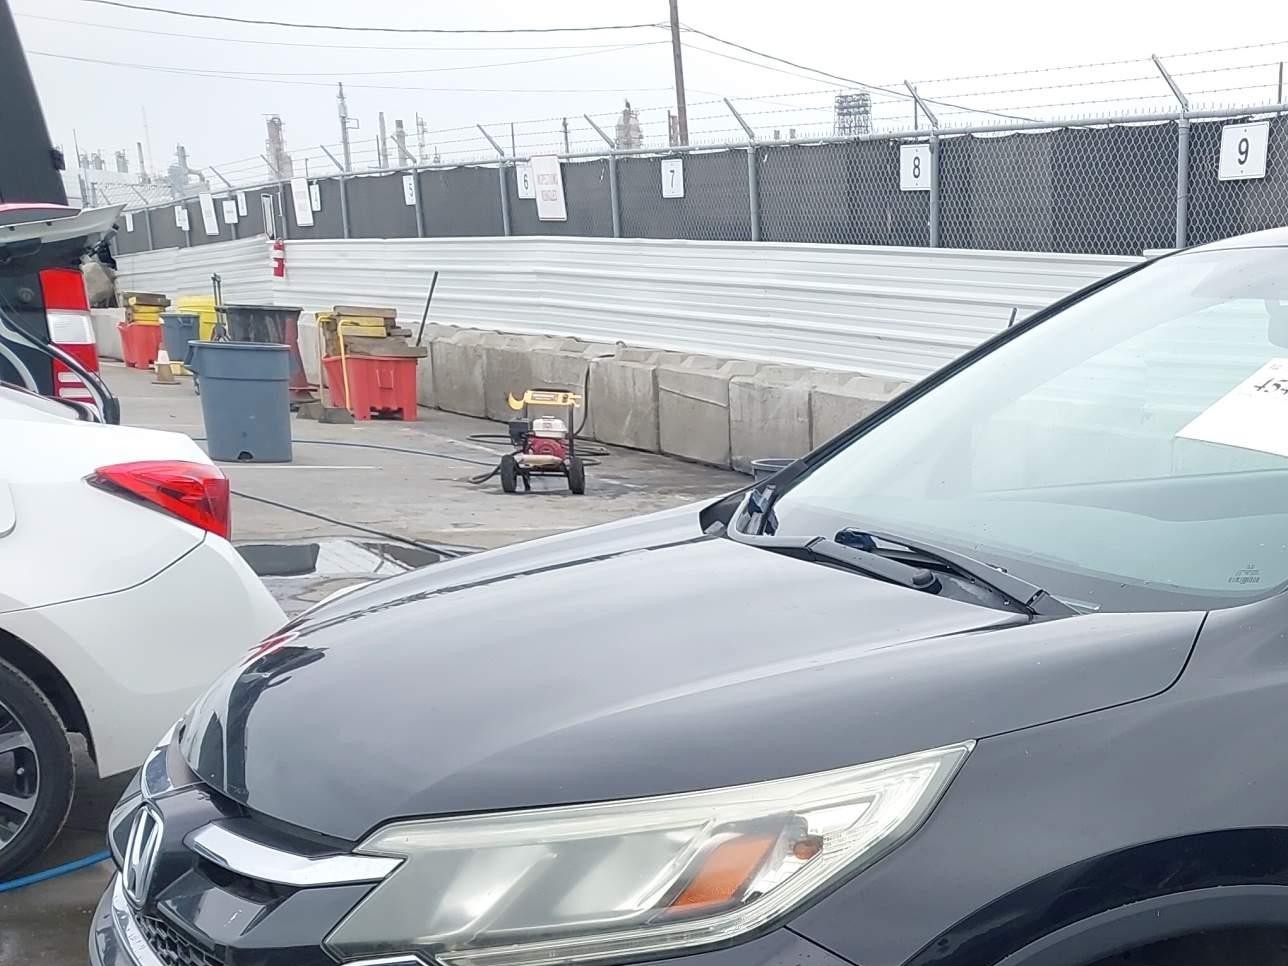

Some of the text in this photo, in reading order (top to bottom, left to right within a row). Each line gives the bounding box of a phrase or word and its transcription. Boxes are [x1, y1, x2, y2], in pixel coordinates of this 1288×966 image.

[1237, 137, 1249, 166] 9
[912, 156, 921, 179] 8
[523, 173, 529, 190] 6
[669, 169, 676, 189] 7
